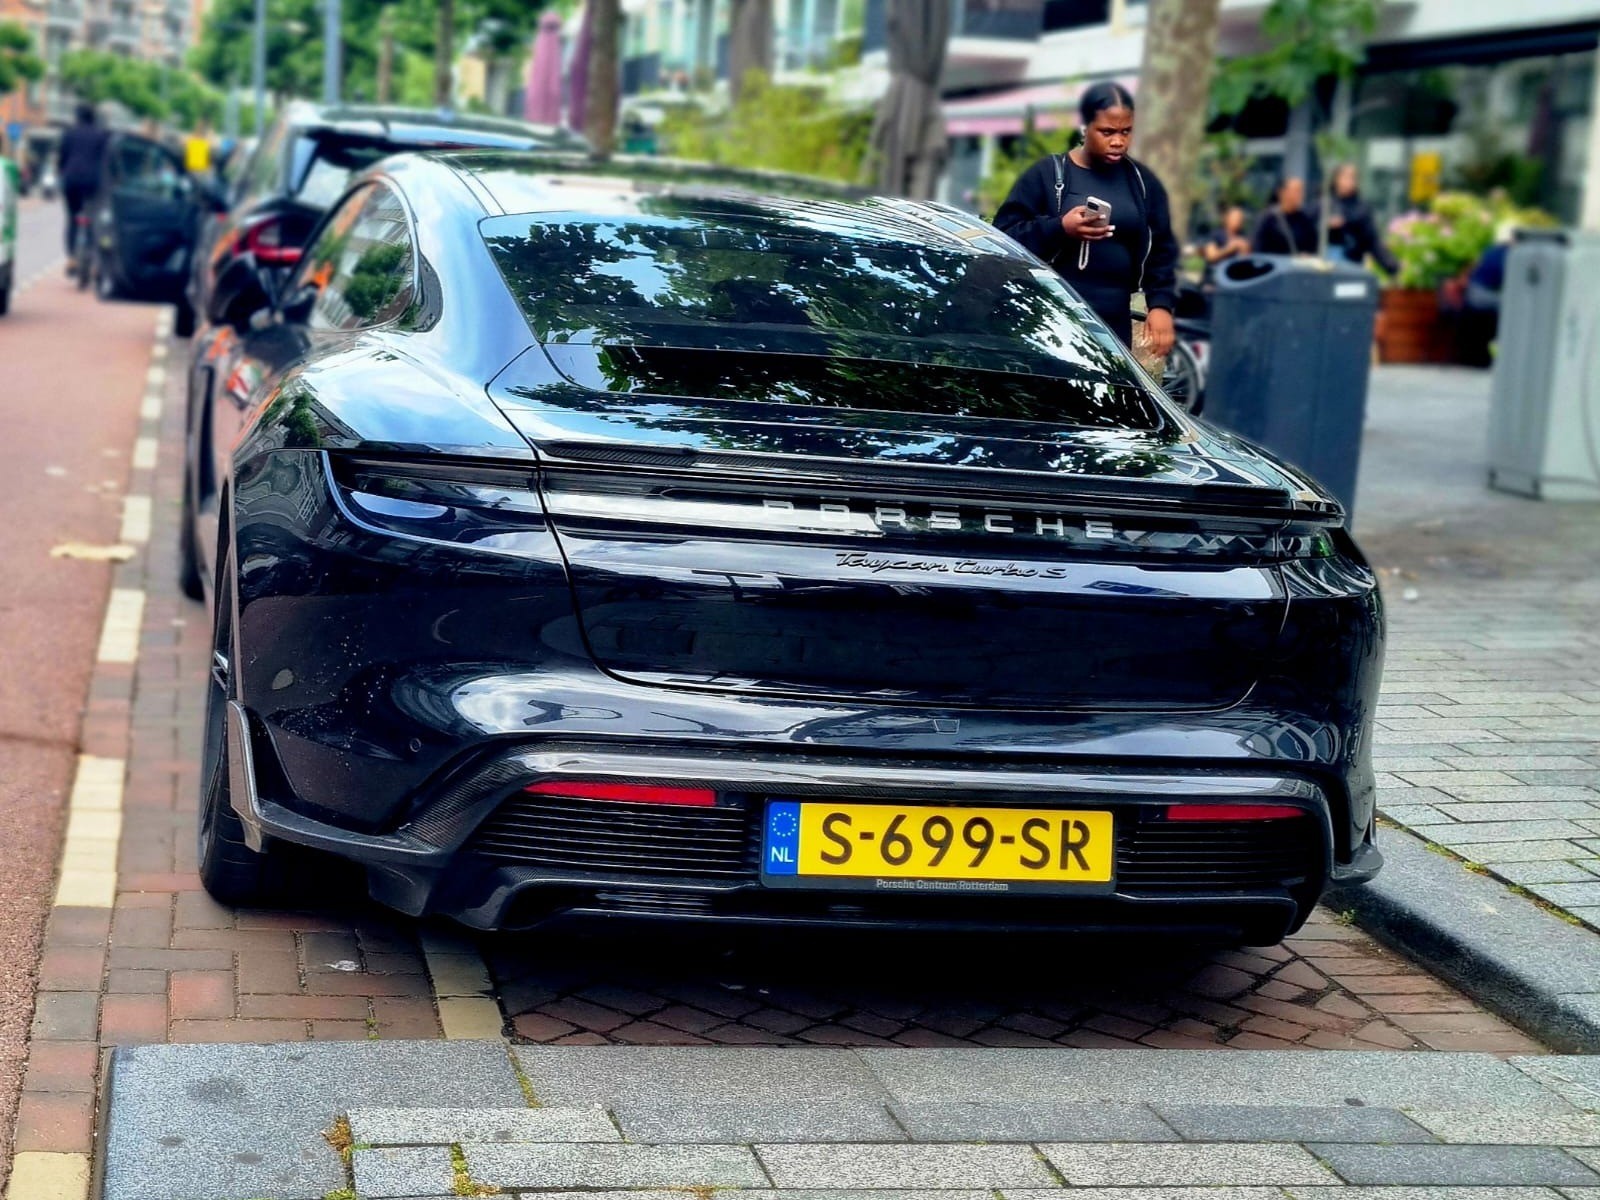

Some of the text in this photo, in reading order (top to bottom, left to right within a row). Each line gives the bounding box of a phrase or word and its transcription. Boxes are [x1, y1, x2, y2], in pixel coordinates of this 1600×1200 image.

[836, 552, 949, 573] Taycan
[1039, 567, 1067, 579] S
[820, 812, 1091, 871] S-699-SR
[771, 846, 794, 863] NL
[876, 878, 1008, 891] Porsche Centrum Rotterdam
